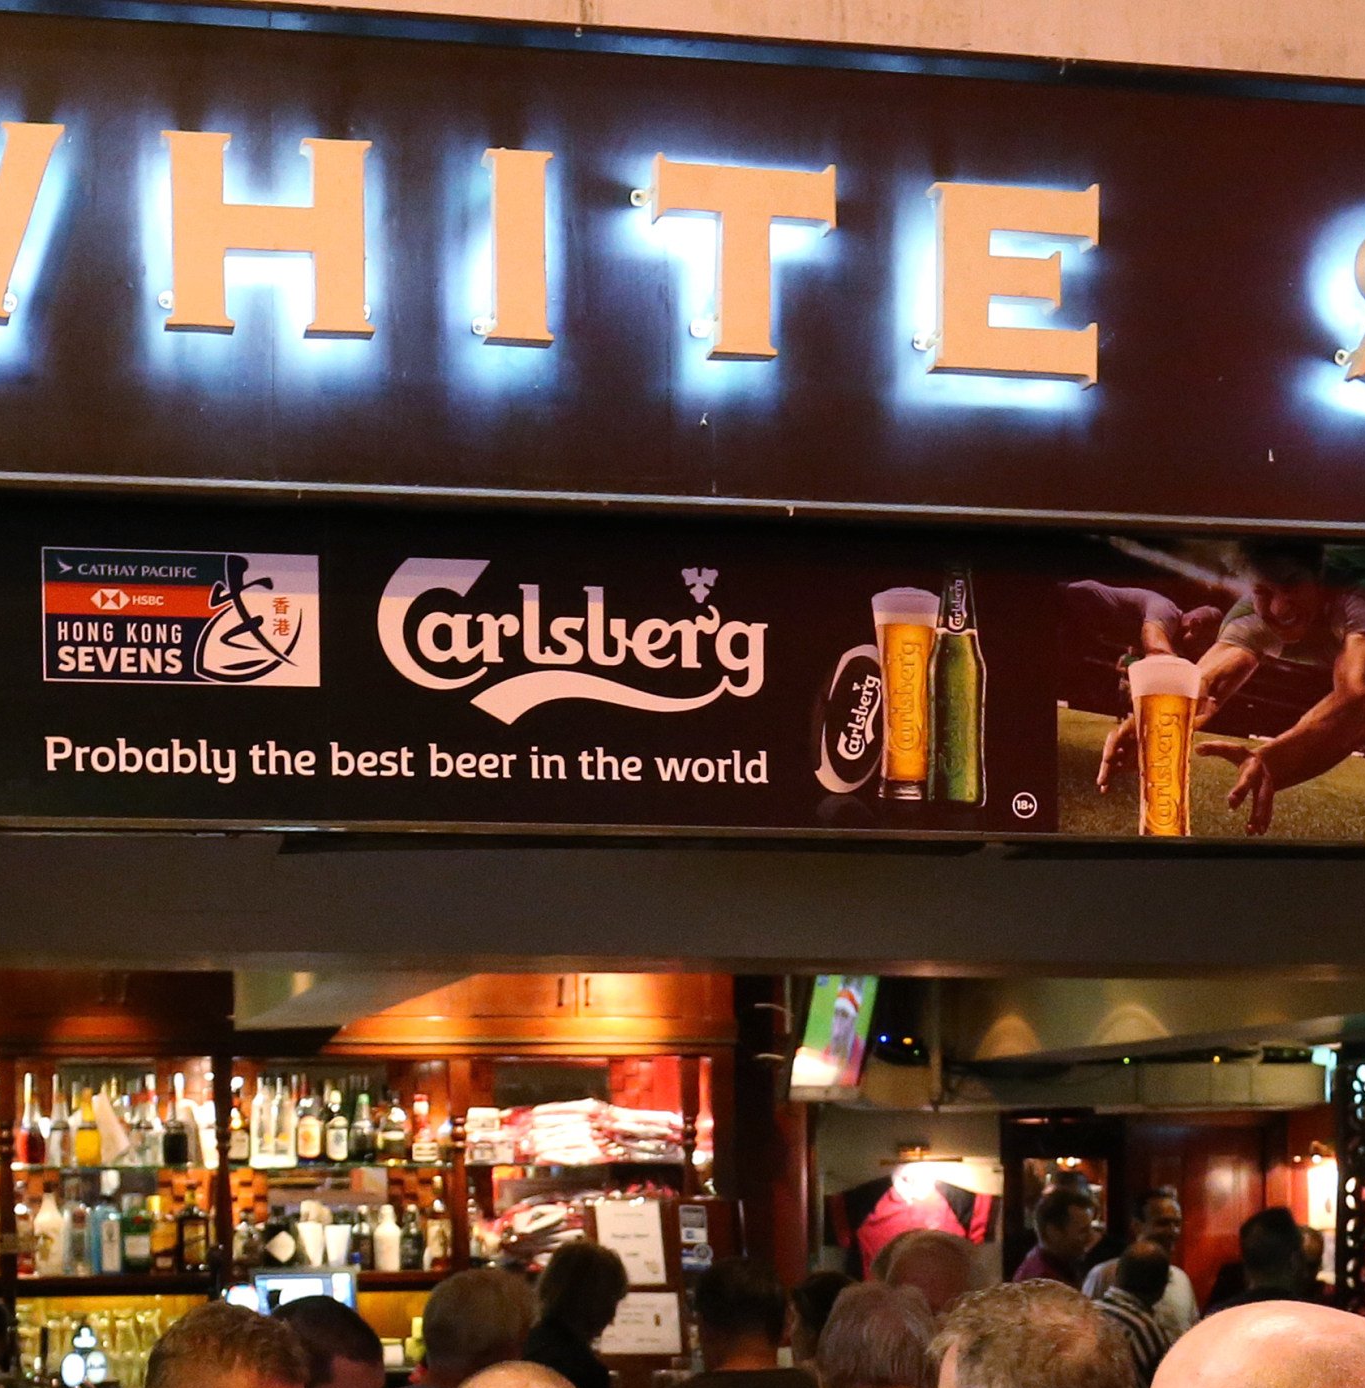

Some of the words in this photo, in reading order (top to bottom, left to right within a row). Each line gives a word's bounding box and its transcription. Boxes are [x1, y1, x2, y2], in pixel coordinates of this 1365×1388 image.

[77, 563, 136, 578] CATHAY
[141, 565, 198, 579] PACIFIC
[131, 594, 165, 607] HSBC
[272, 596, 291, 637] 香港
[57, 621, 115, 643] HONG
[126, 623, 183, 644] KONG
[377, 557, 769, 726] Carlsberg
[57, 646, 184, 675] SEVENS
[836, 673, 882, 761] Carlsberg
[44, 736, 237, 784] Probably
[249, 740, 317, 776] the
[329, 742, 416, 777] best
[428, 743, 517, 779] beer
[529, 746, 568, 780] in
[578, 747, 643, 781] the
[654, 749, 770, 784] world
